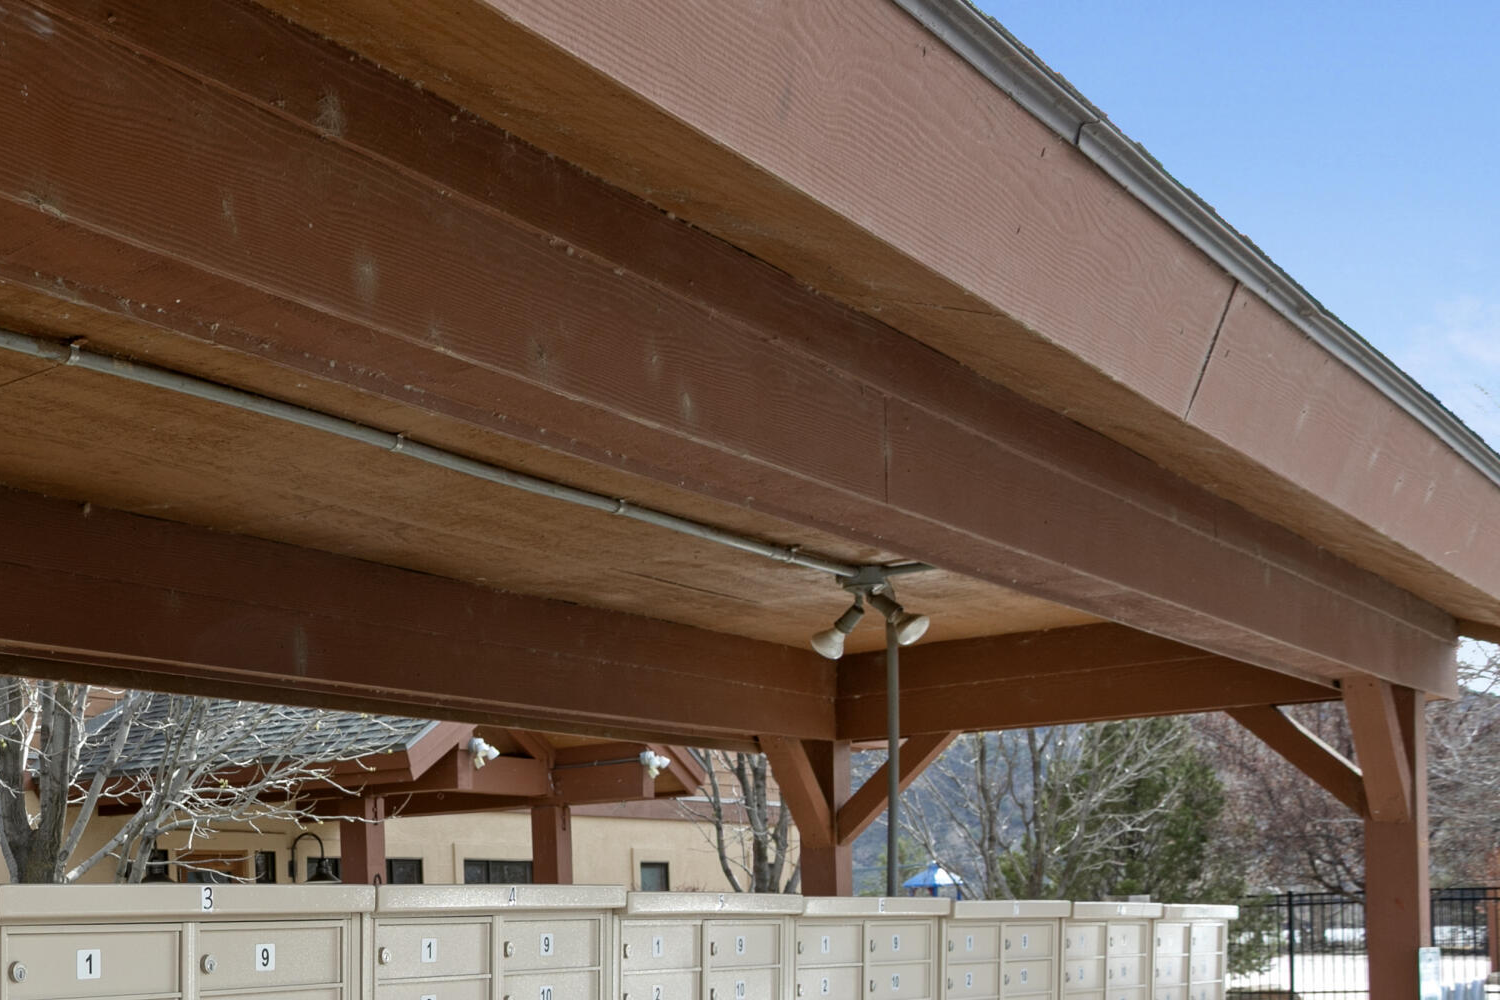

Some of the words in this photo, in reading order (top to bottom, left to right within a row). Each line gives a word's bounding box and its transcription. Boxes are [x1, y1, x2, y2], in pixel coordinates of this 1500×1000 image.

[203, 886, 213, 910] 3
[426, 941, 433, 959] 1
[543, 936, 550, 953] 9
[738, 938, 744, 952] 9
[85, 953, 93, 975] 1
[261, 948, 270, 967] 9
[736, 982, 745, 997] 10
